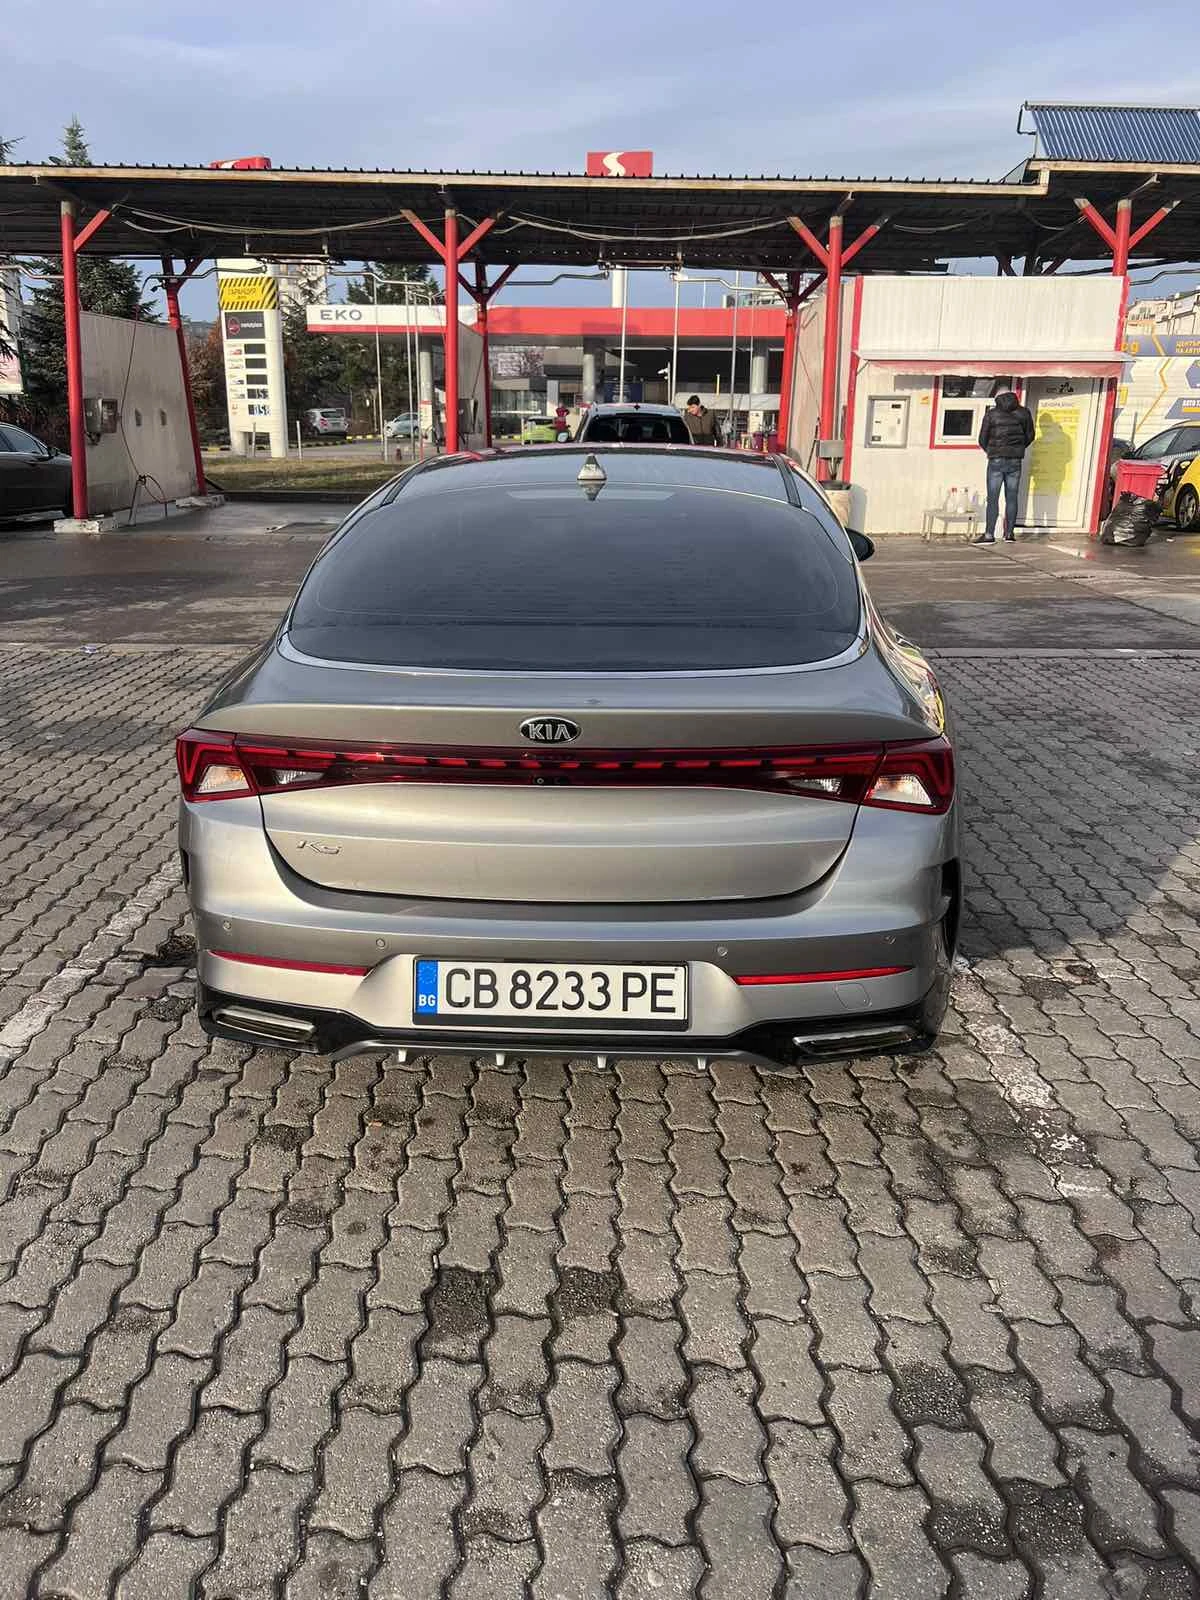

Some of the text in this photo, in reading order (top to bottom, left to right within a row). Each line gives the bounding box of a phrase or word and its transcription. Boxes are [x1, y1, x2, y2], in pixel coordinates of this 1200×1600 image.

[320, 309, 362, 321] EKO
[528, 723, 571, 740] KIA
[445, 968, 676, 1013] CB 8233 PE
[418, 994, 436, 1007] BG
